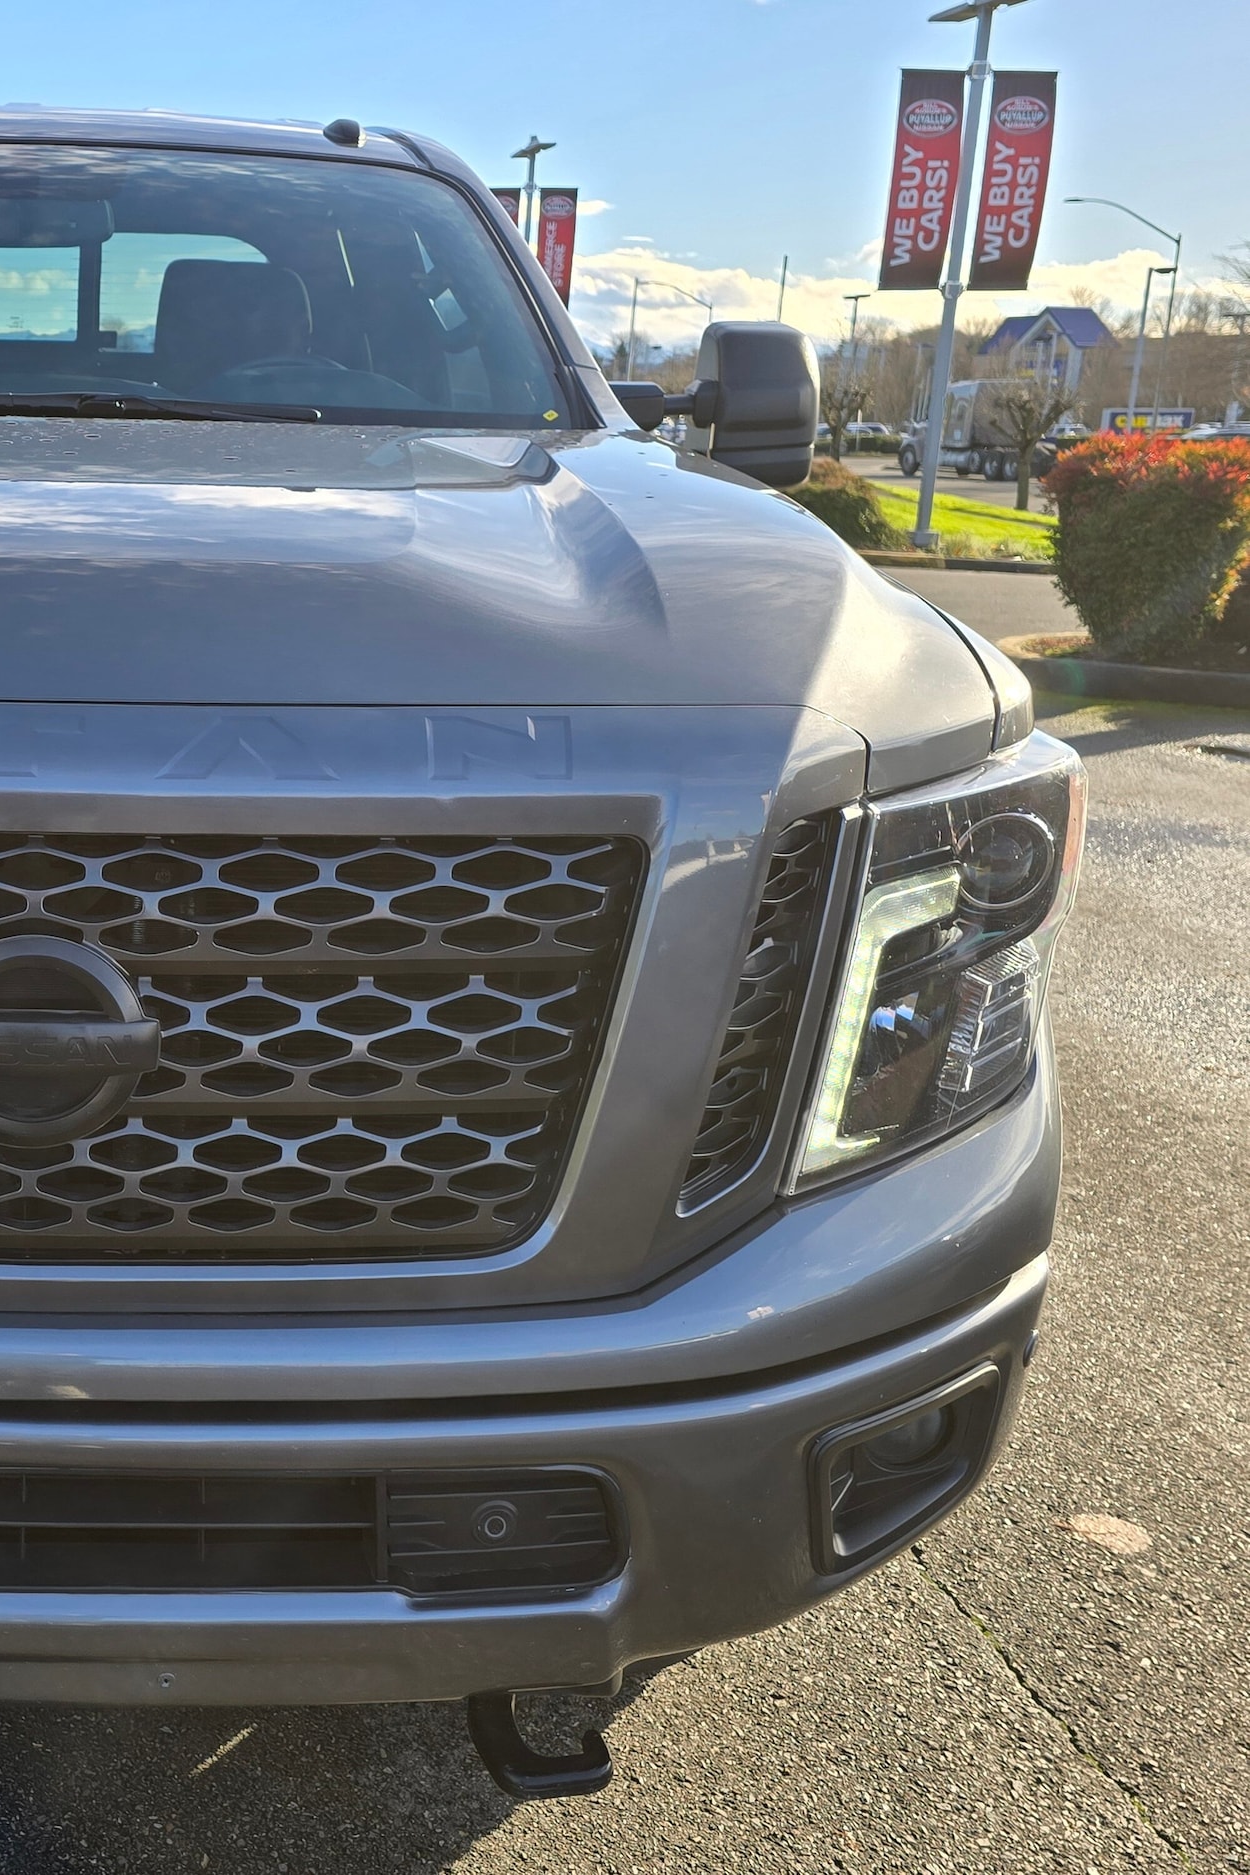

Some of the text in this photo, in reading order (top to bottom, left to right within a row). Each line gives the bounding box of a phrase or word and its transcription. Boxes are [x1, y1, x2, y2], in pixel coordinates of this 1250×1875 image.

[908, 113, 953, 124] PUYALLUP
[1000, 110, 1044, 121] PUYALLUP
[889, 144, 925, 267] WE BUY
[916, 159, 950, 251] CARS!
[978, 141, 1016, 263] WE BUY
[1007, 156, 1041, 249] CARS!
